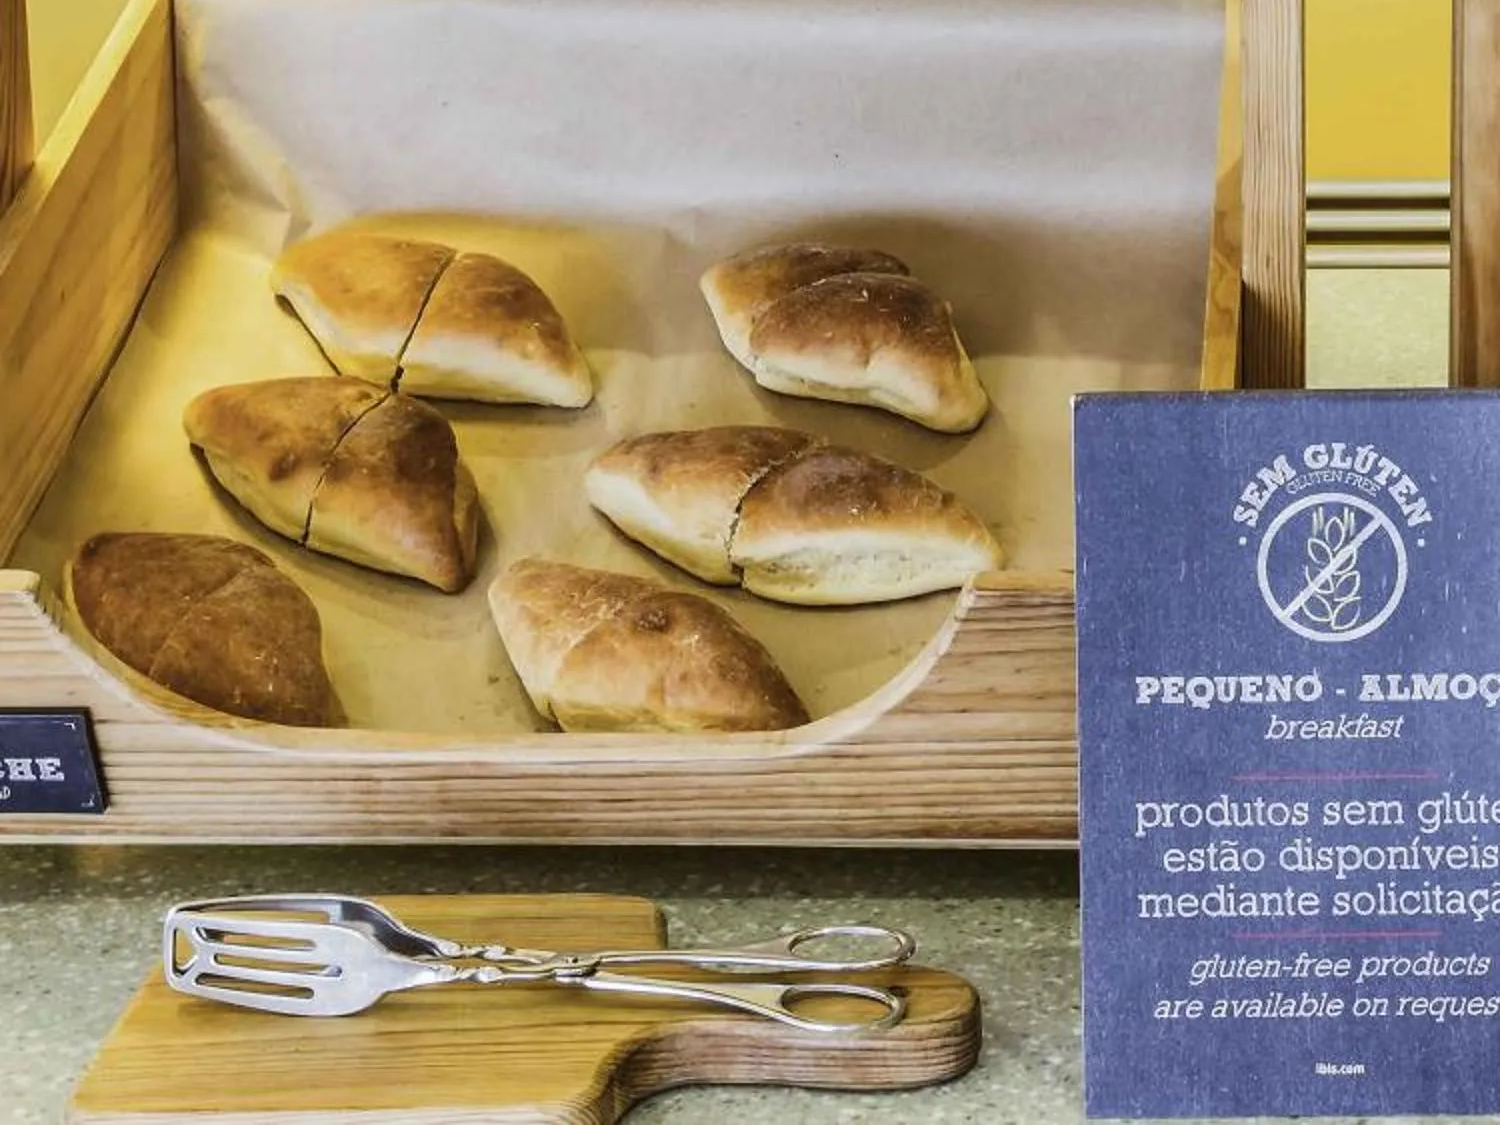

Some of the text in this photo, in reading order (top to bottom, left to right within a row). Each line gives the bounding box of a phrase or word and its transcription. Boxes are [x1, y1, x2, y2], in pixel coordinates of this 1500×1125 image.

[1233, 442, 1433, 528] SEM GLÚTEN
[1286, 470, 1381, 497] GLUTEN FREE
[1264, 714, 1405, 740] breakfast
[1135, 794, 1309, 837] produtos
[1322, 800, 1405, 827] sem
[1162, 835, 1499, 880] estão disponíveis
[1137, 884, 1320, 919] mediante
[1189, 951, 1491, 985] gluten-free products
[1154, 997, 1204, 1019] are
[1210, 993, 1345, 1019] available
[1352, 996, 1388, 1017] on
